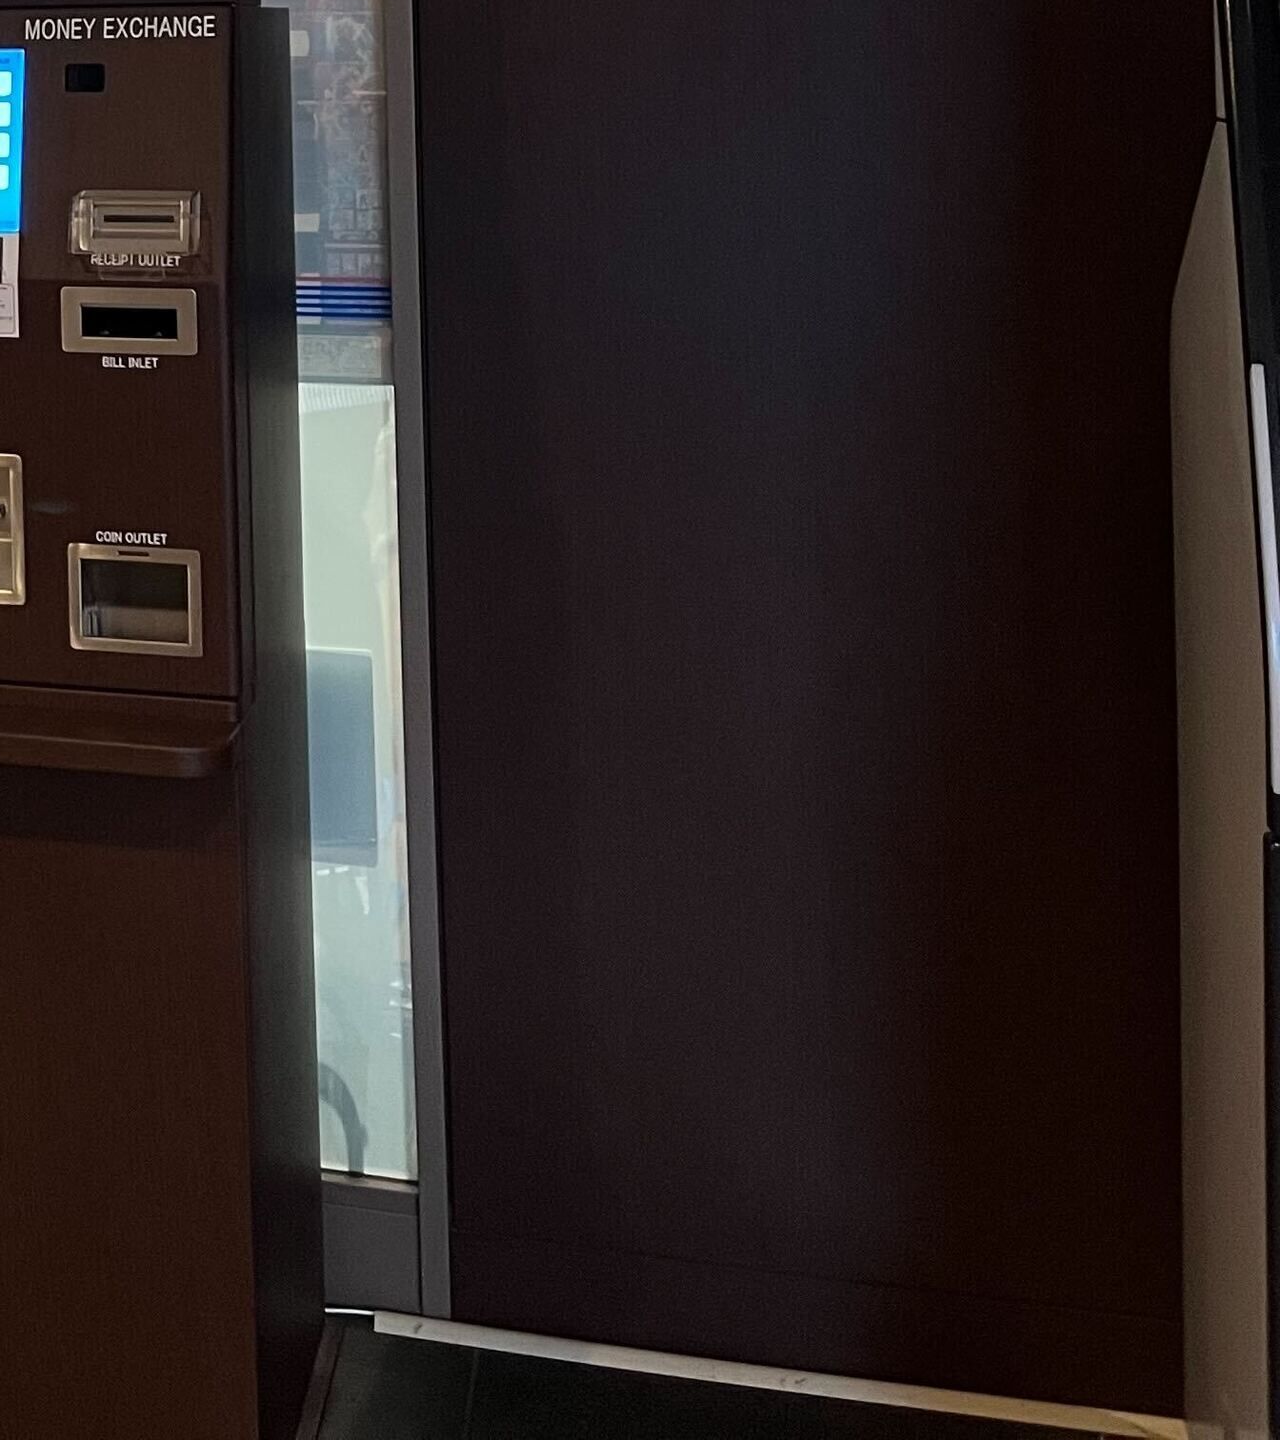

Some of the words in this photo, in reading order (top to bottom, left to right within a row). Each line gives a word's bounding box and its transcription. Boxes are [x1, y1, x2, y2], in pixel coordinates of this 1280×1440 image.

[24, 18, 96, 40] MONEY
[103, 15, 216, 39] EXCHANGE
[102, 356, 126, 368] BILL
[128, 357, 159, 369] INLET
[95, 530, 123, 543] COIN
[125, 531, 168, 545] OUTLET
